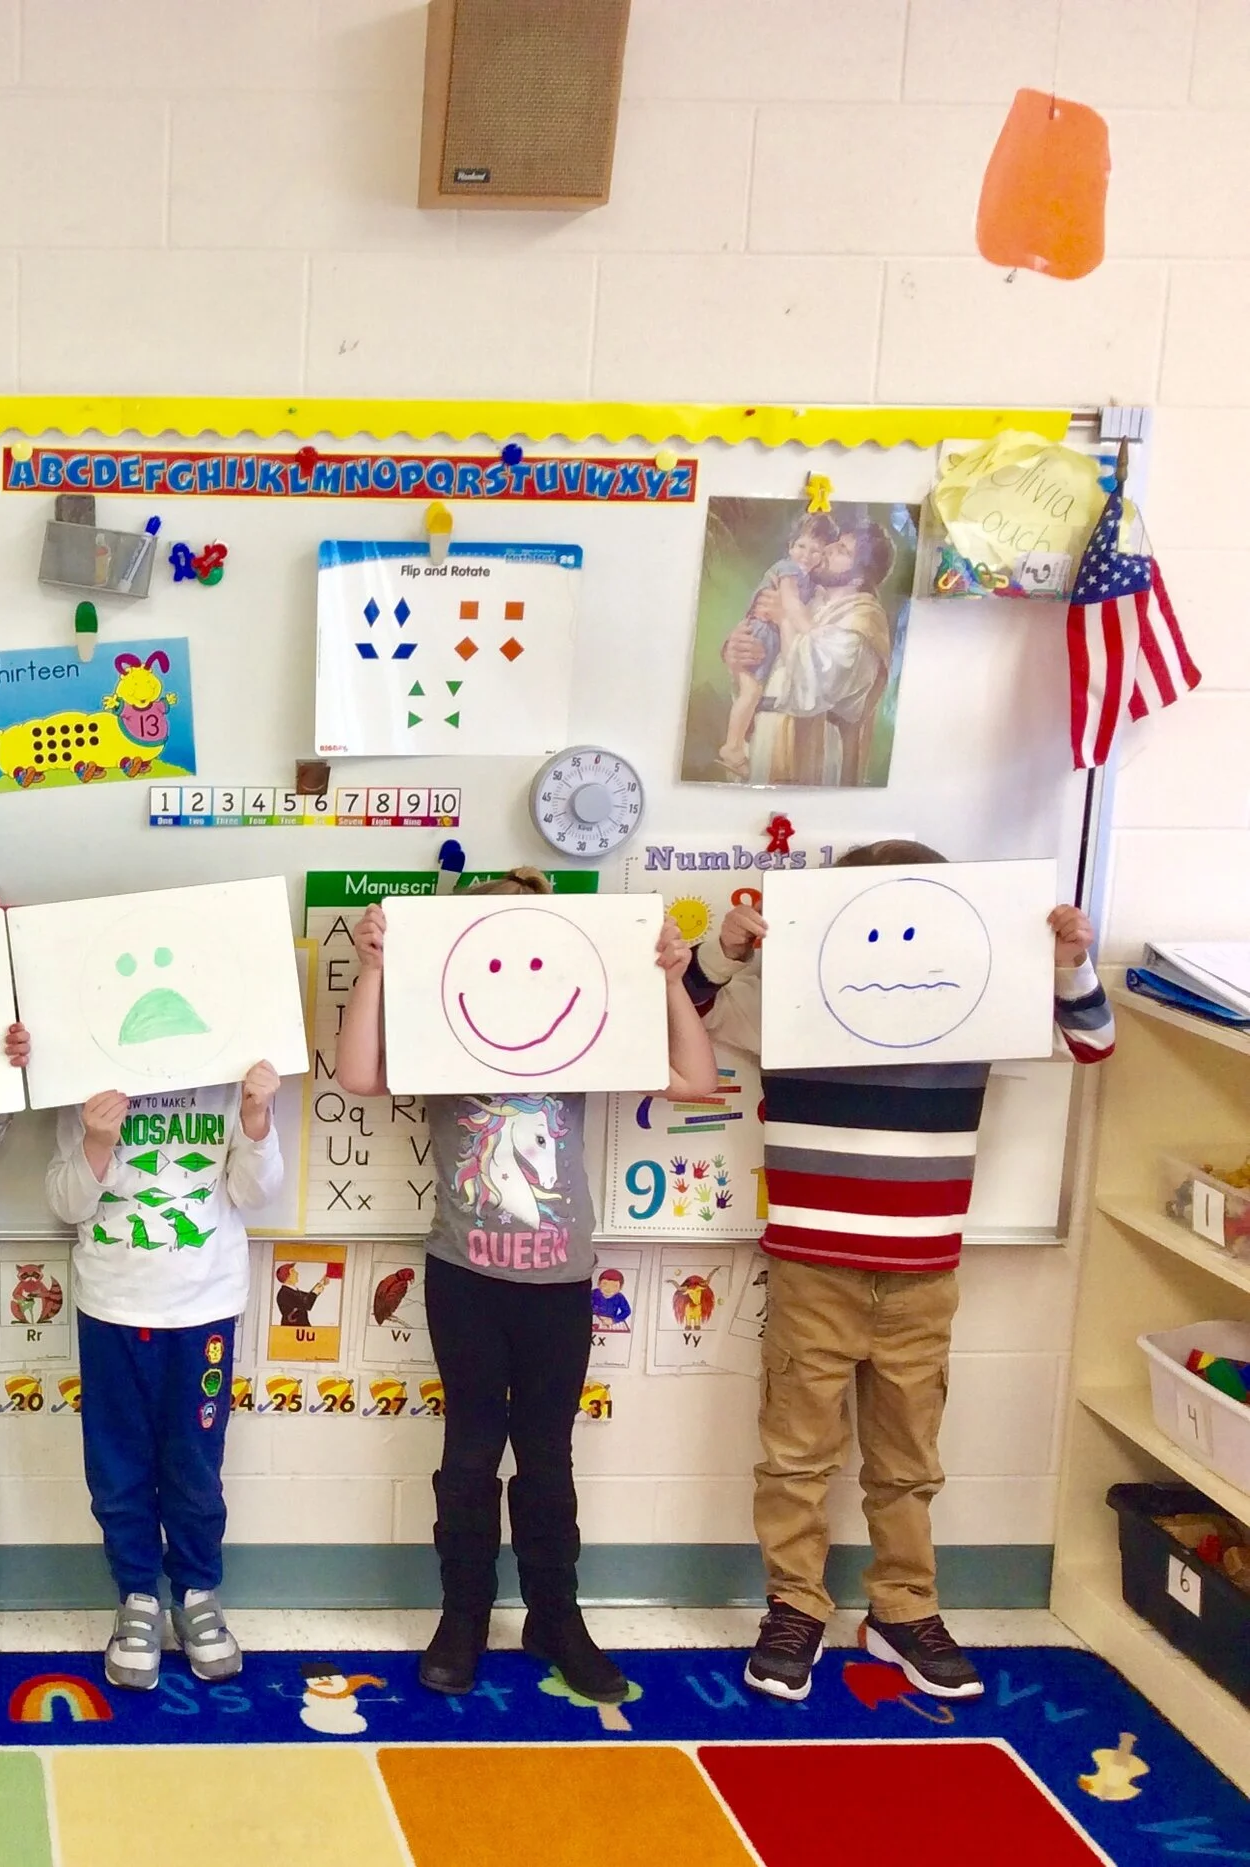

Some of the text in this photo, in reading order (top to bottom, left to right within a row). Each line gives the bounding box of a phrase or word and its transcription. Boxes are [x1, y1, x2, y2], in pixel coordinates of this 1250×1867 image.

[401, 565, 490, 578] Flip and Rotate
[140, 714, 160, 737] 13
[571, 757, 581, 767] 55
[594, 754, 601, 764] 0
[614, 762, 621, 772] 5
[552, 770, 562, 781] 50
[627, 782, 637, 792] 10
[161, 792, 456, 813] 1 2 3 4 5 6 7 8 9 10
[542, 792, 551, 802] 45
[629, 803, 639, 814] 15
[543, 813, 553, 823] 40
[556, 832, 566, 842] 35
[618, 824, 628, 834] 20
[576, 841, 586, 851] 30
[598, 837, 609, 848] 25
[645, 845, 807, 871] Numbers
[344, 874, 437, 895] Manuscri
[146, 1097, 158, 1108] TO
[162, 1097, 186, 1108] MAKE
[190, 1098, 196, 1107] A
[315, 1093, 373, 1136] Qq
[118, 1113, 225, 1146] NOSAUR!
[329, 1136, 368, 1165] Uu
[327, 1180, 371, 1210] Xx
[625, 1160, 667, 1220] 9
[468, 1228, 569, 1270] QUEEN
[27, 1329, 42, 1342] Rr
[295, 1329, 315, 1341] Uu
[392, 1330, 411, 1342] Vv
[683, 1334, 702, 1348] Yy
[11, 1392, 43, 1411] 20
[272, 1393, 302, 1412] 25
[323, 1394, 356, 1413] 26
[377, 1396, 408, 1416] 27
[589, 1400, 612, 1418] 31
[1187, 1404, 1198, 1439] 4
[1180, 1564, 1190, 1592] 6
[159, 1672, 252, 1715] Ss
